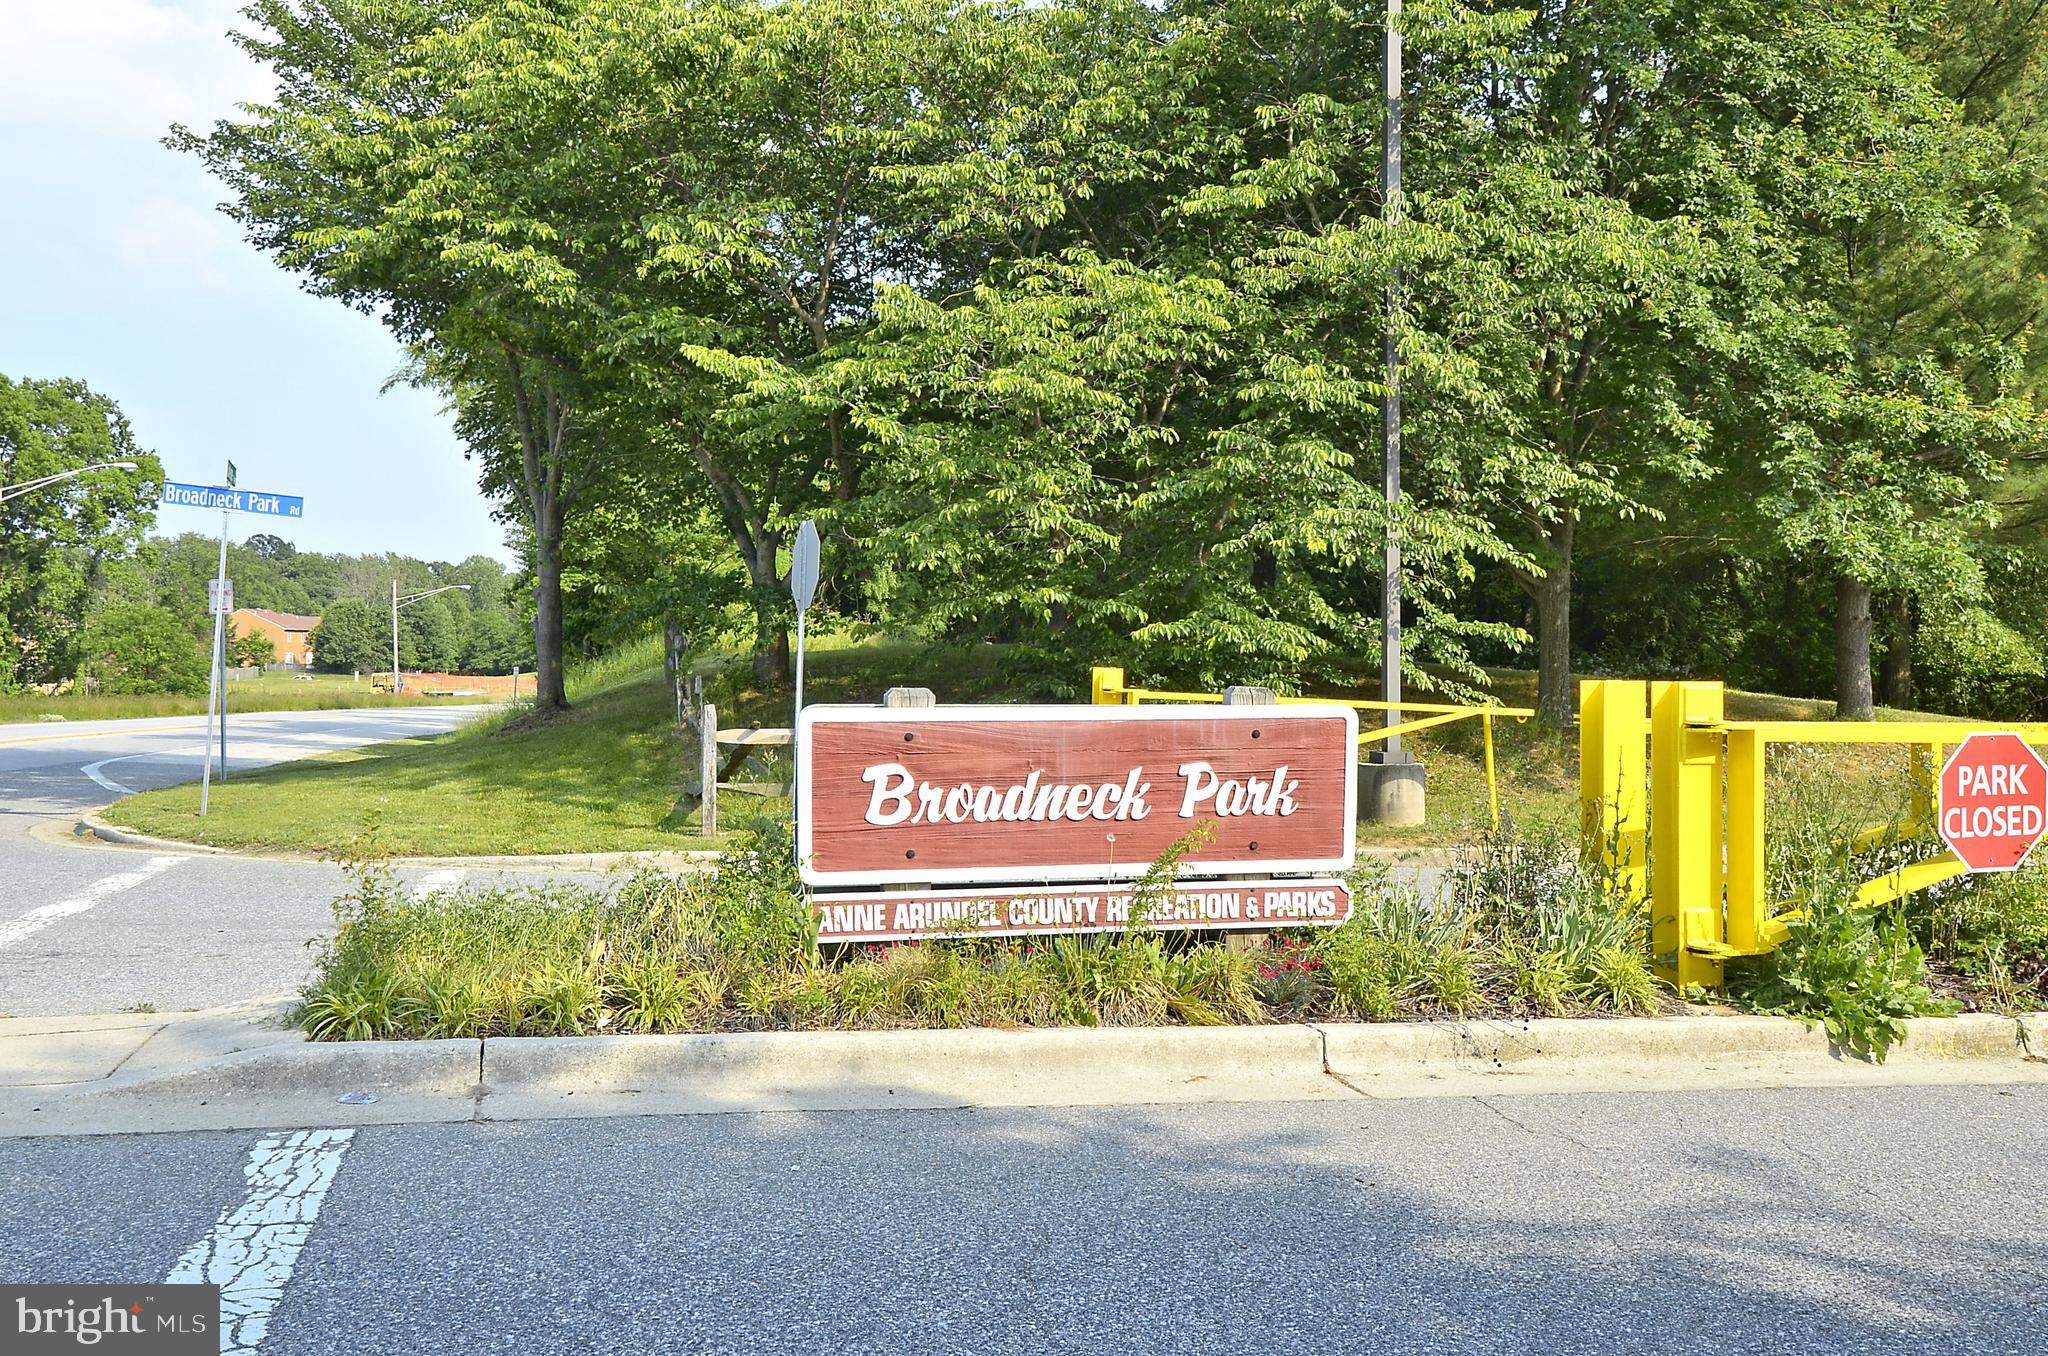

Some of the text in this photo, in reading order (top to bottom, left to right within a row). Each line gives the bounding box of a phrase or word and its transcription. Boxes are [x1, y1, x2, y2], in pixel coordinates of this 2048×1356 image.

[165, 484, 300, 516] Broadneck Park Rd
[861, 761, 1299, 826] Broadneck Park
[1958, 764, 2029, 797] PARK
[1944, 804, 2043, 839] CLOSED
[819, 903, 886, 934] ANNE
[892, 899, 1002, 931] ARUNDEL
[1008, 896, 1100, 927] COUNTY
[1246, 896, 1260, 919] &
[1263, 891, 1336, 918] PARKS
